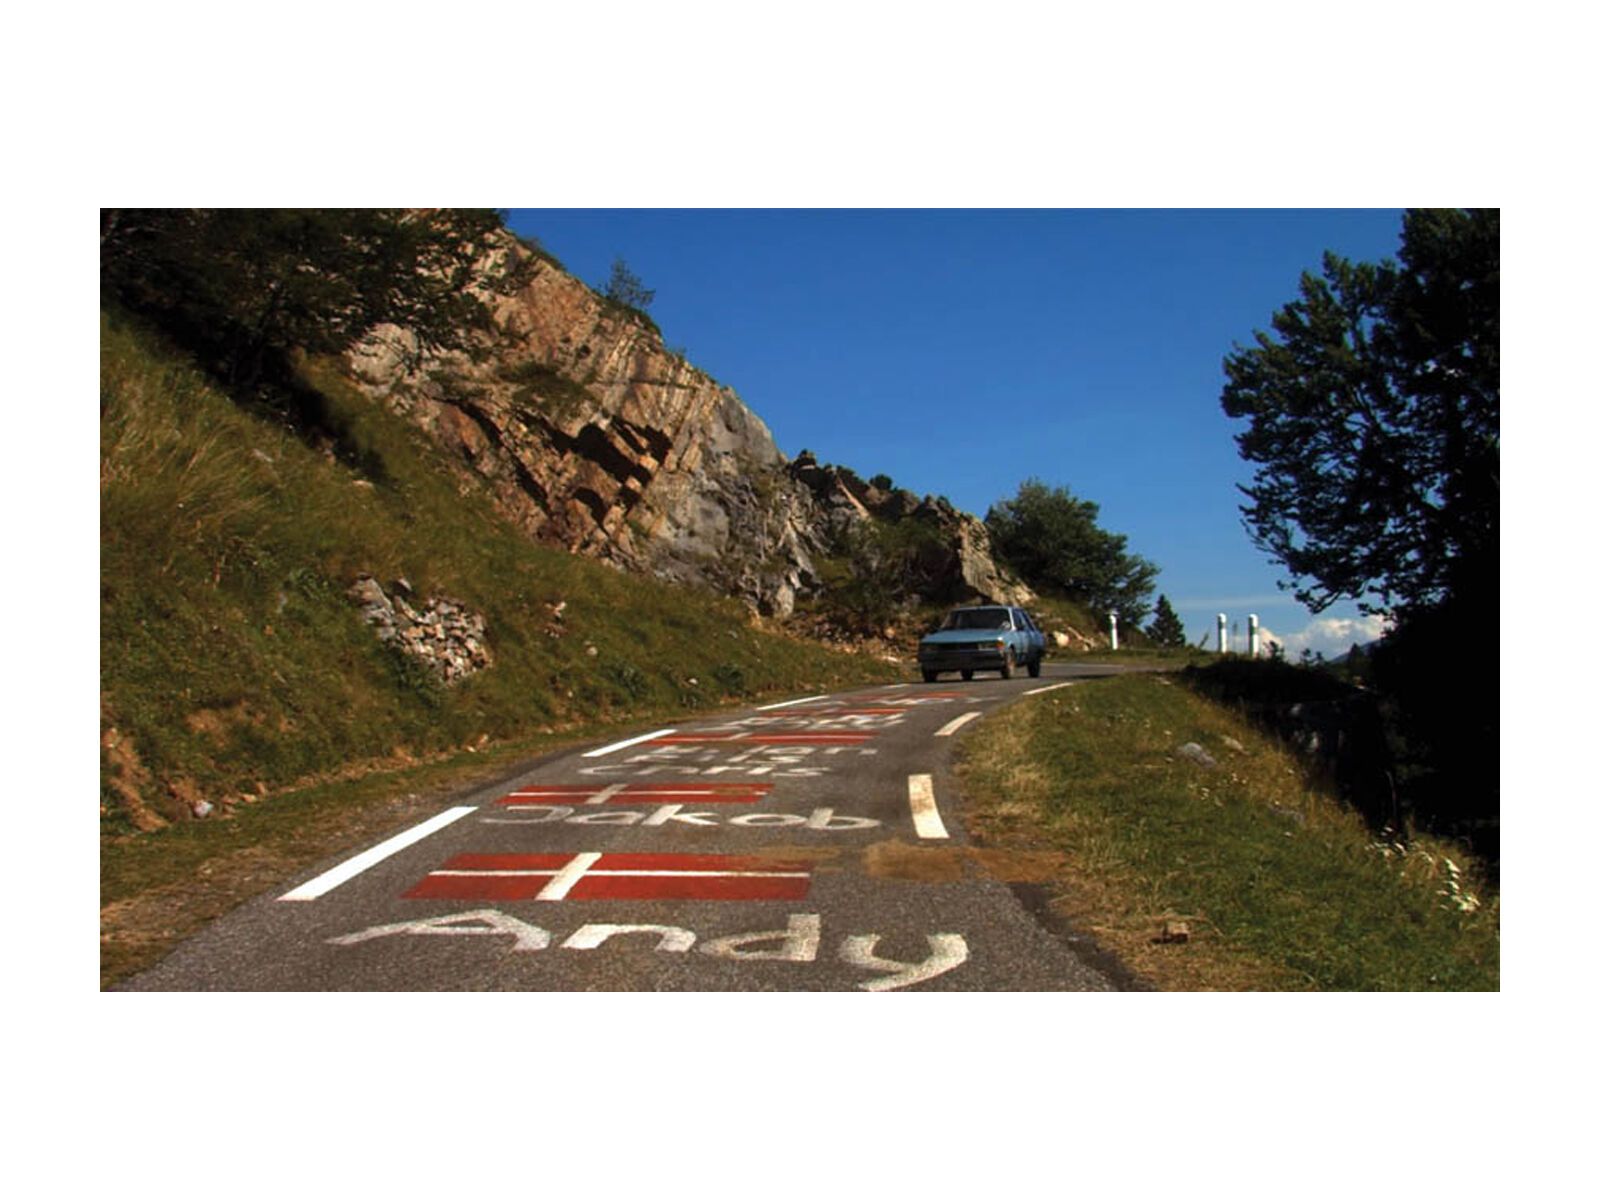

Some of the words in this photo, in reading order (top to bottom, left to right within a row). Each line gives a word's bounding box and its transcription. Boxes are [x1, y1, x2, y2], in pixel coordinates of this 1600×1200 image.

[576, 763, 832, 777] Chris
[479, 804, 882, 830] Jakob
[325, 908, 969, 992] Andy
